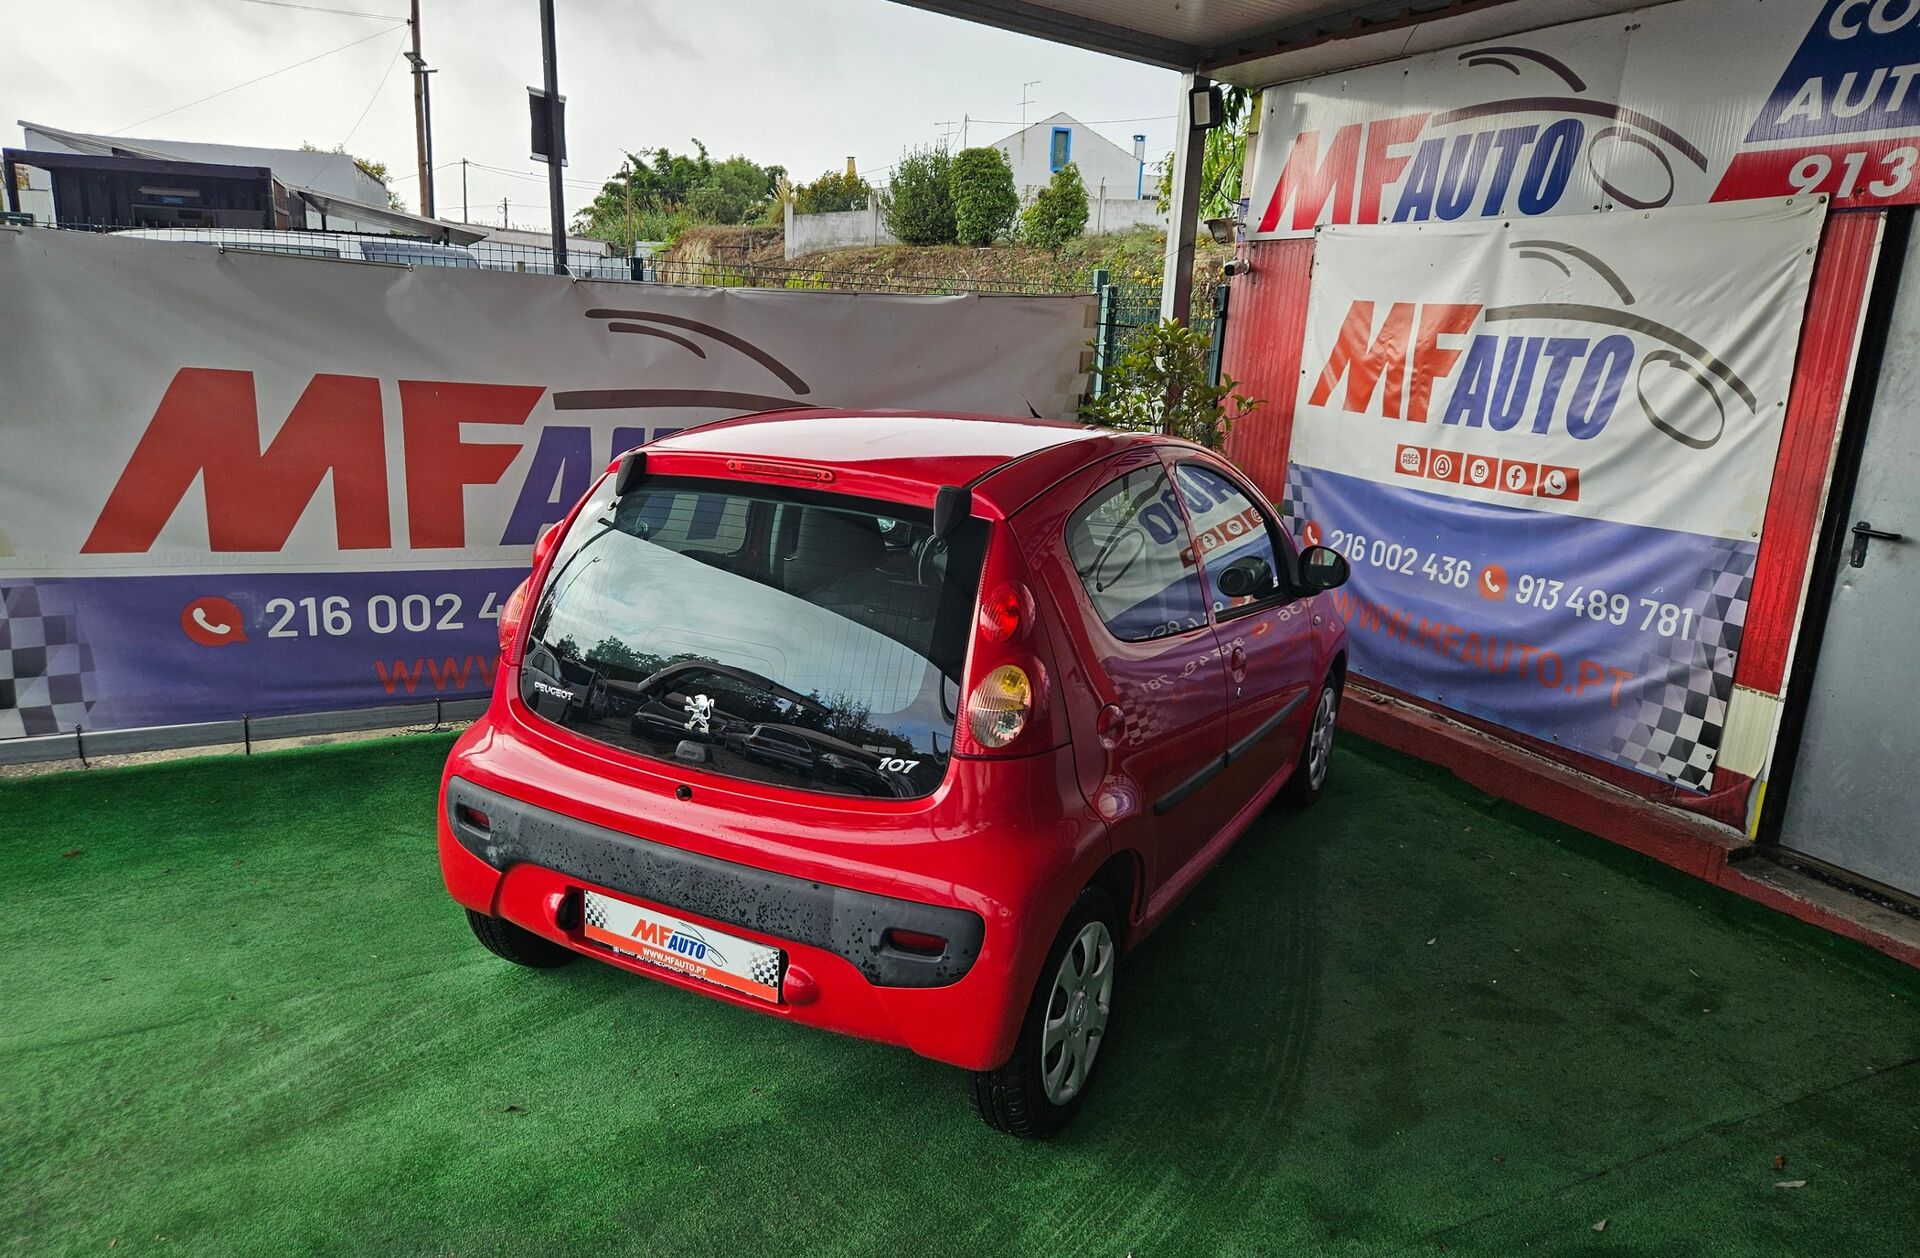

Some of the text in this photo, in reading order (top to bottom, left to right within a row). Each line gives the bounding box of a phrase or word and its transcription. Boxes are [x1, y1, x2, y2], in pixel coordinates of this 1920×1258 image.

[1788, 146, 1920, 198] 913
[1329, 529, 1472, 588] 216 002 436
[266, 596, 351, 637] 216
[367, 593, 464, 634] 002
[1515, 575, 1693, 641] 913 489 781
[1332, 590, 1635, 708] WWW.MFAUTO.PT
[534, 681, 574, 700] PEUGEOT
[878, 757, 920, 774] 107
[642, 947, 707, 976] WWW.MFAUTO.PT
